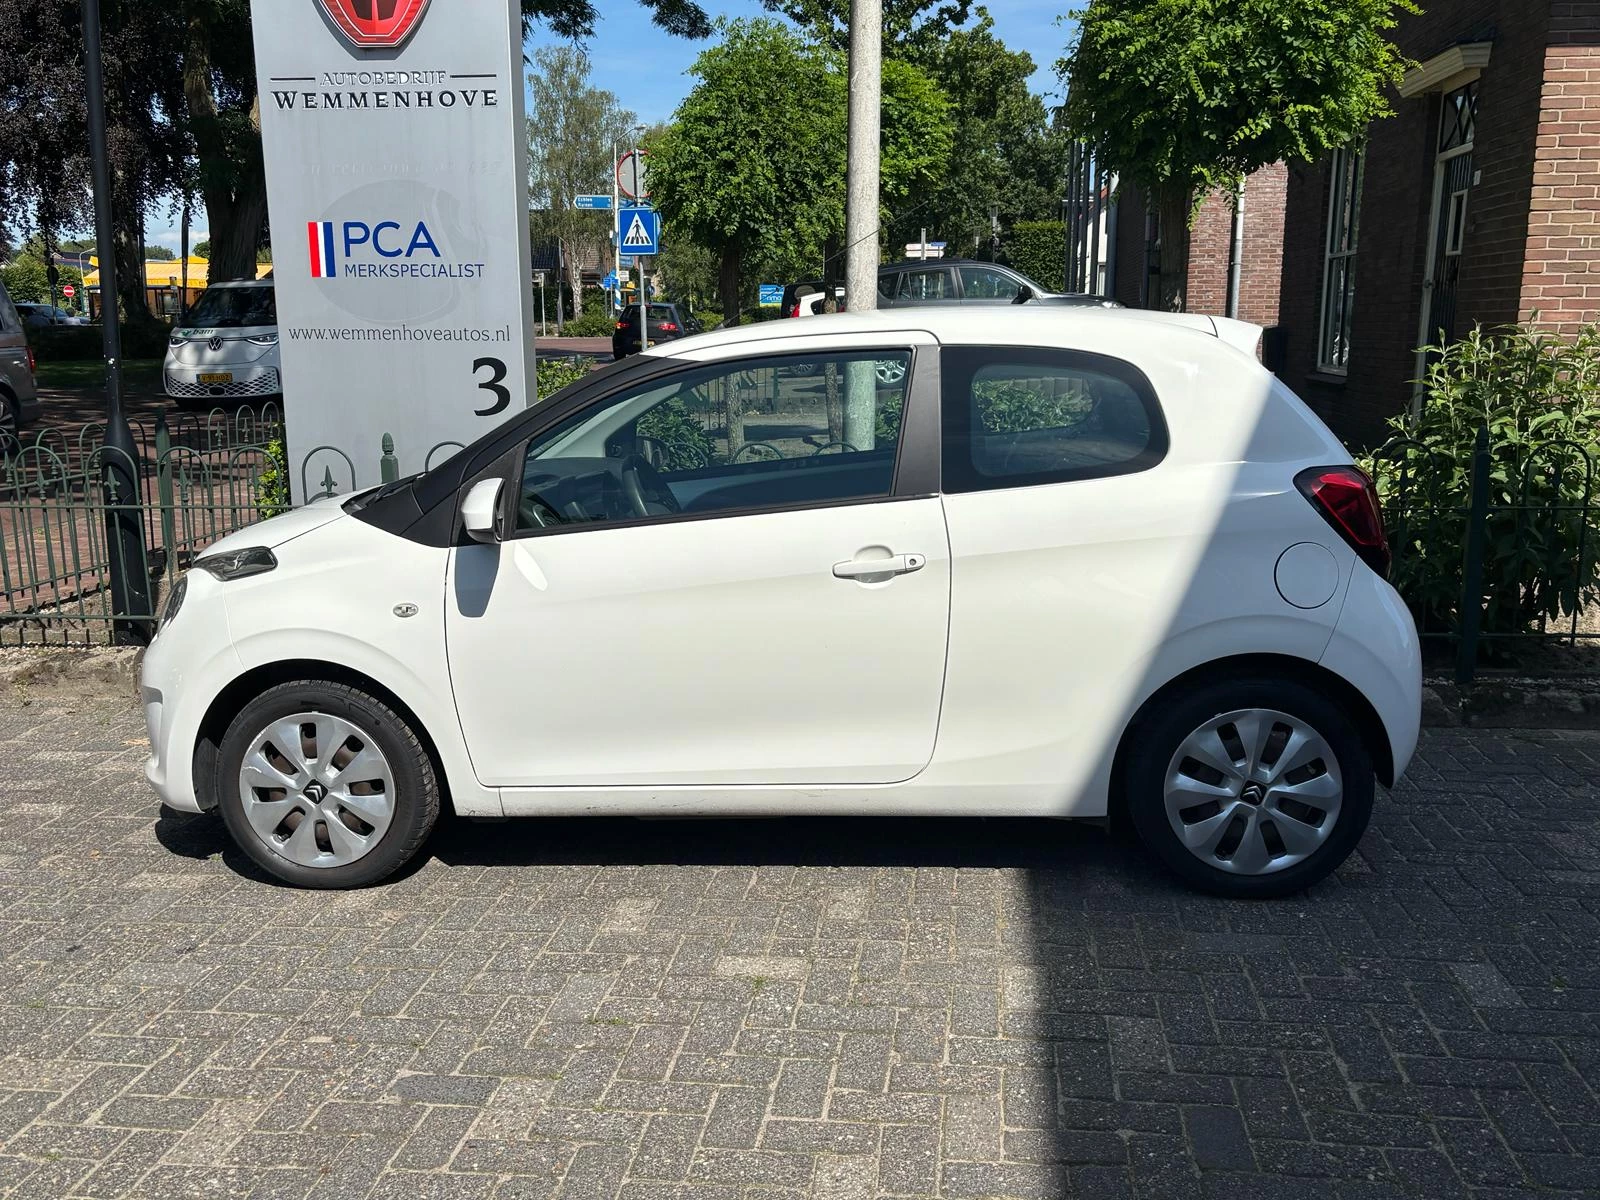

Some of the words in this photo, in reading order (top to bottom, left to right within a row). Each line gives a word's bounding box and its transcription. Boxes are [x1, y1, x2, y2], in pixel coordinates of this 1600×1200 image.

[320, 70, 447, 87] AUTOBEDRIJF
[270, 89, 498, 110] WEMMENHOVE
[342, 220, 441, 258] PCA
[344, 263, 485, 278] MERKSPECIALIST
[288, 323, 511, 342] www.wemmenhoveautos.nl
[472, 356, 511, 417] 3
